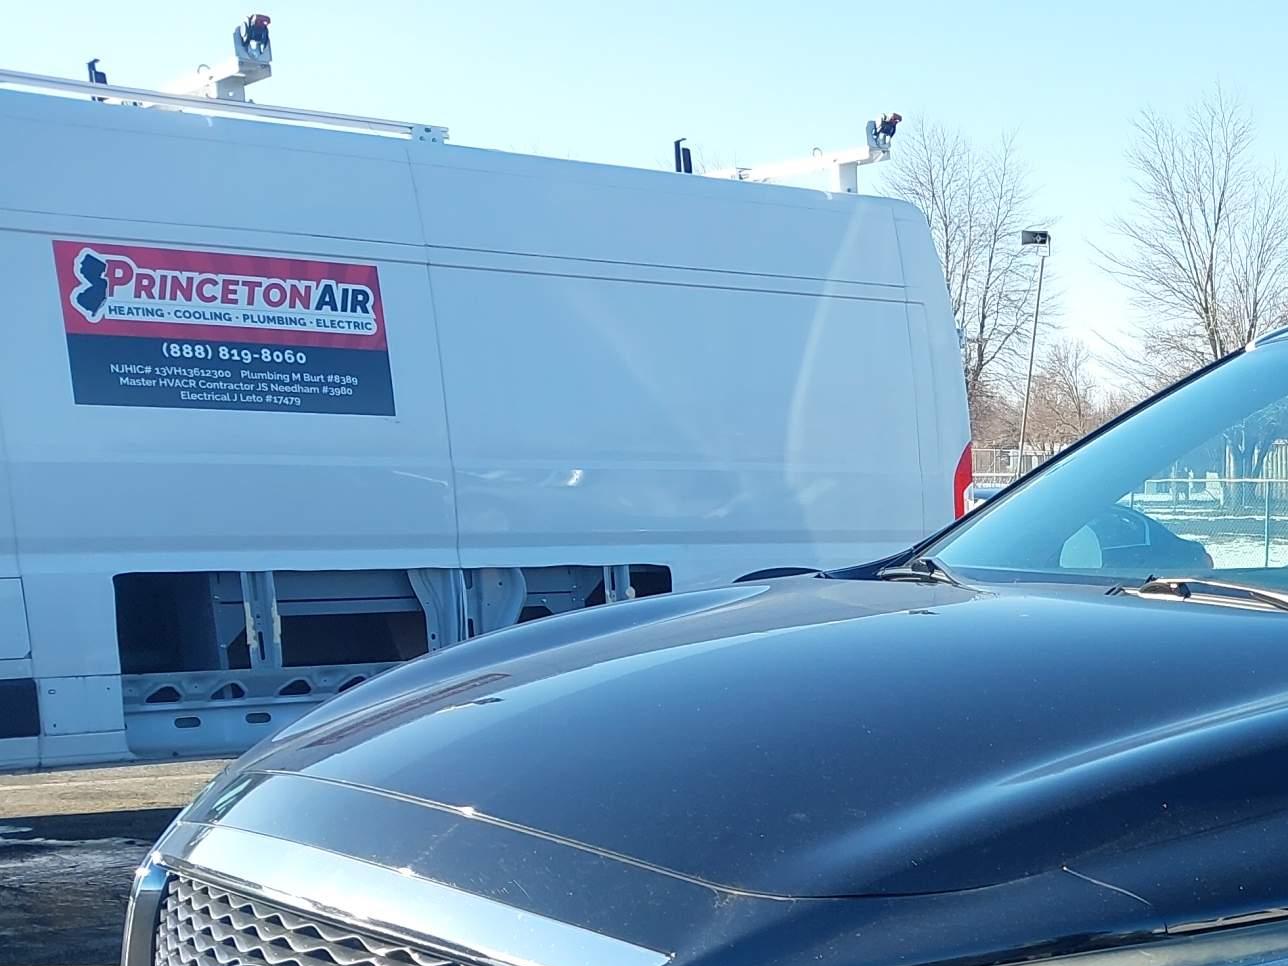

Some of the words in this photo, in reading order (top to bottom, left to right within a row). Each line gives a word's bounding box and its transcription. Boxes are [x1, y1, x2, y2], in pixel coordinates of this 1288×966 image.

[108, 305, 165, 318] HEATING
[173, 309, 233, 322] COOLING
[242, 313, 307, 327] PLUMBING
[316, 318, 373, 331] ELECTRIC
[162, 342, 213, 360] (888)
[218, 346, 307, 364] 819-8060
[110, 364, 152, 374] NJHIC#
[240, 370, 290, 383] Plumbing
[291, 372, 301, 382] M
[303, 373, 325, 383] Burt
[327, 375, 359, 386] #8389
[119, 377, 157, 387] Master
[159, 378, 197, 389] HVACR
[198, 380, 255, 391] Contractor
[270, 383, 320, 394] Needham
[180, 391, 232, 402] Electrical
